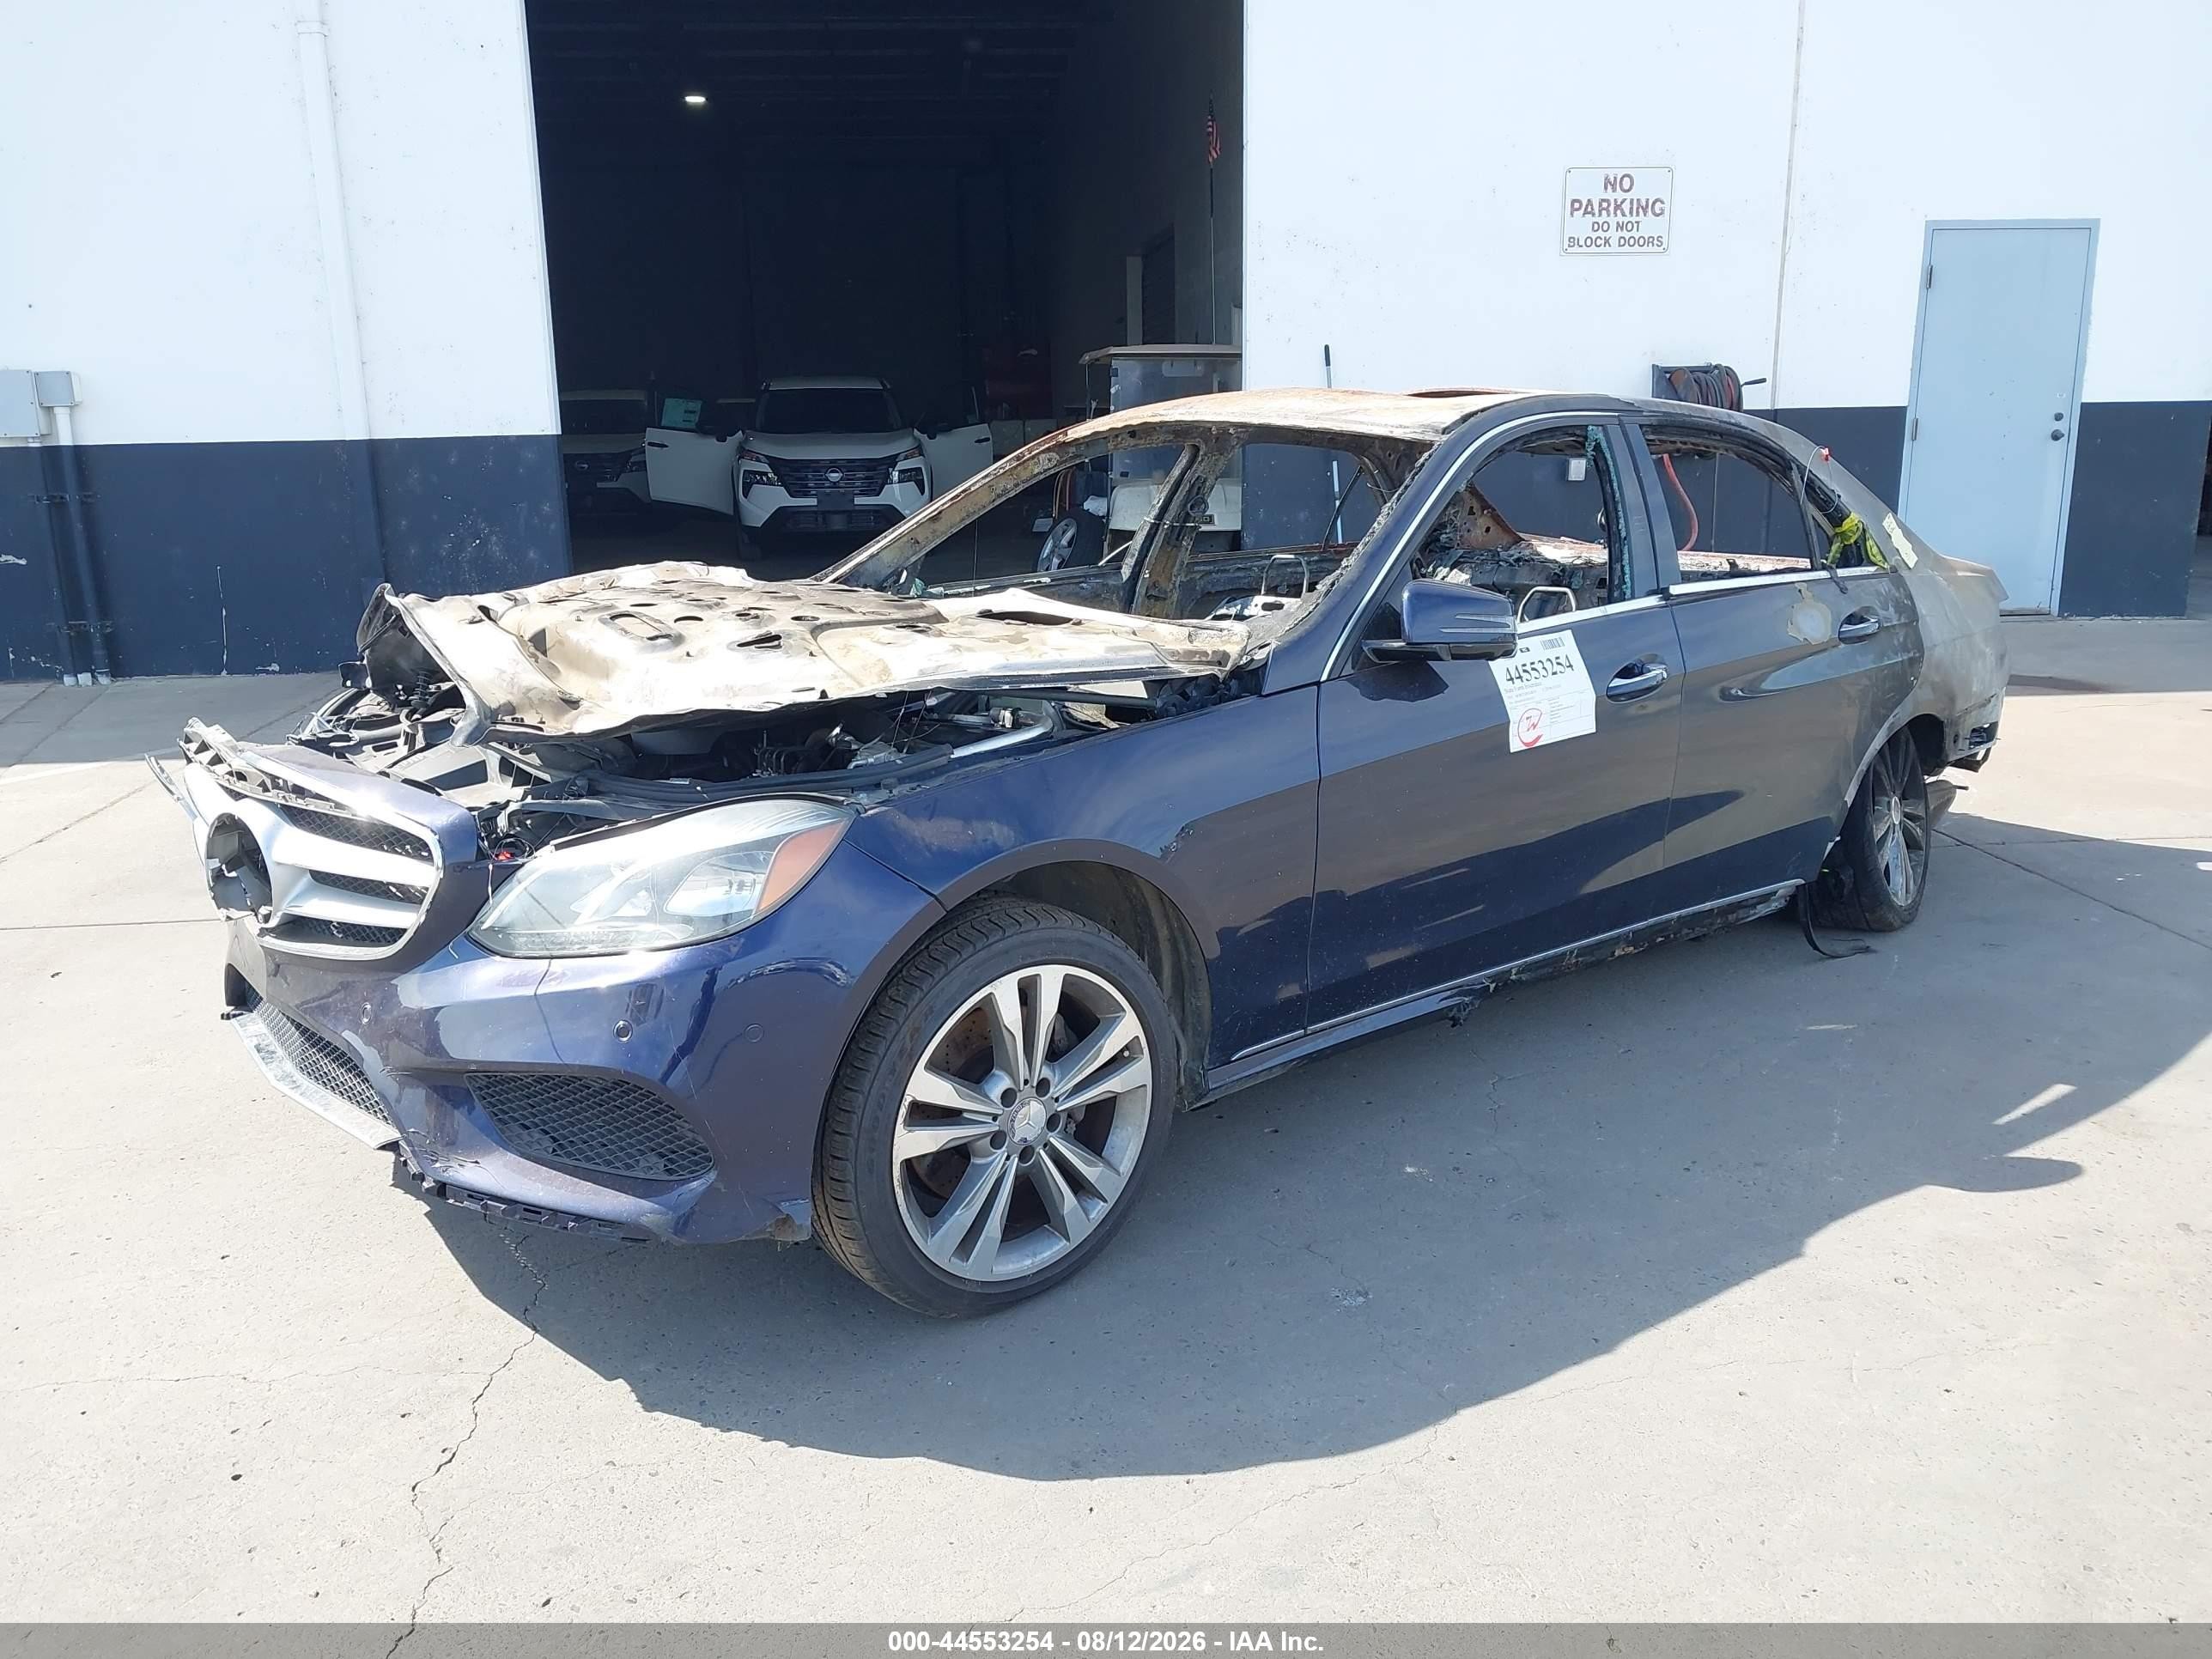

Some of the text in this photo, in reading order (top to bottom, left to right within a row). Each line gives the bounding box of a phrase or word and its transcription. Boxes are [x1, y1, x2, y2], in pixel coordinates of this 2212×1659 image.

[1603, 173, 1635, 193] NO
[1569, 198, 1666, 218] PARKING
[1591, 220, 1642, 233] DO NOT
[1567, 235, 1664, 248] BLOCK DOORS
[1505, 654, 1575, 684] 44553254
